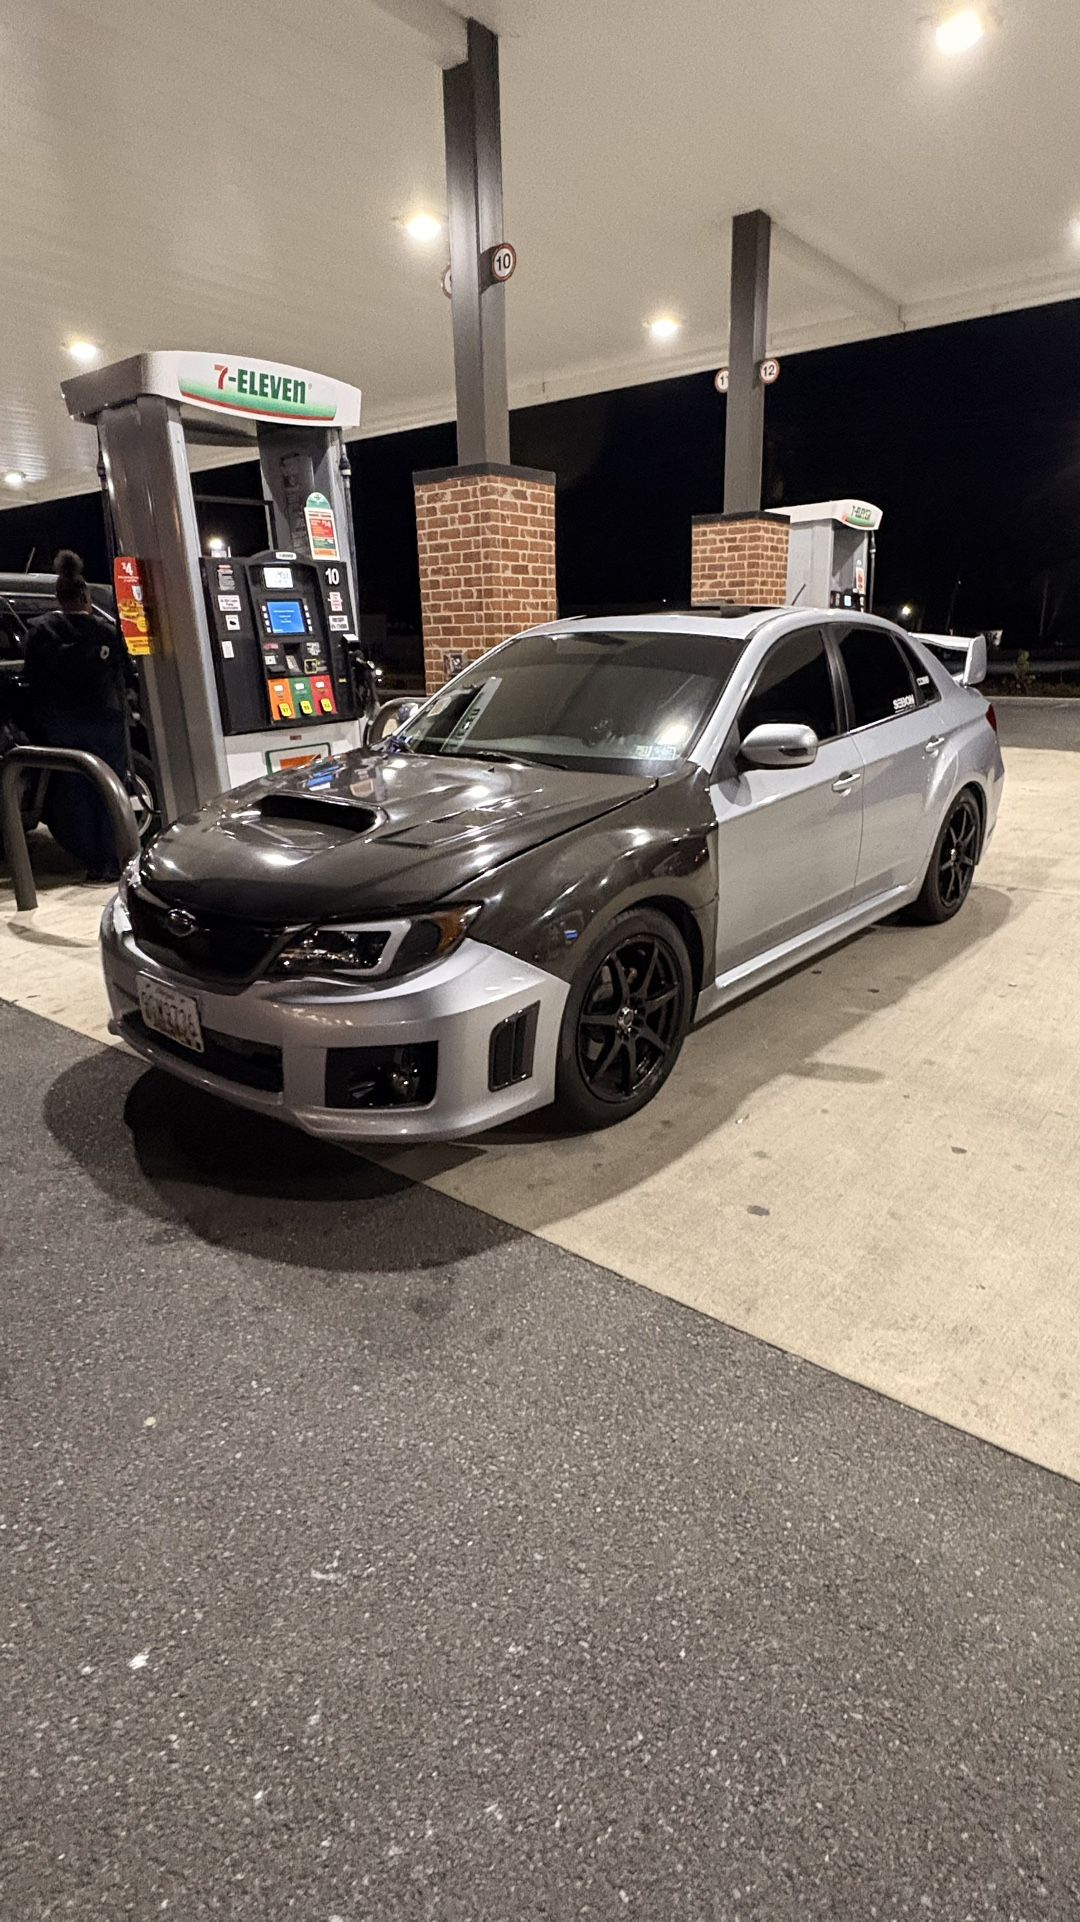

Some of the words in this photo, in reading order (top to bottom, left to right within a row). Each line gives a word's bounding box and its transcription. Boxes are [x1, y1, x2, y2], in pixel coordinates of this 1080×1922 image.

[495, 253, 511, 271] 10
[763, 364, 775, 377] 12
[325, 567, 340, 585] 10
